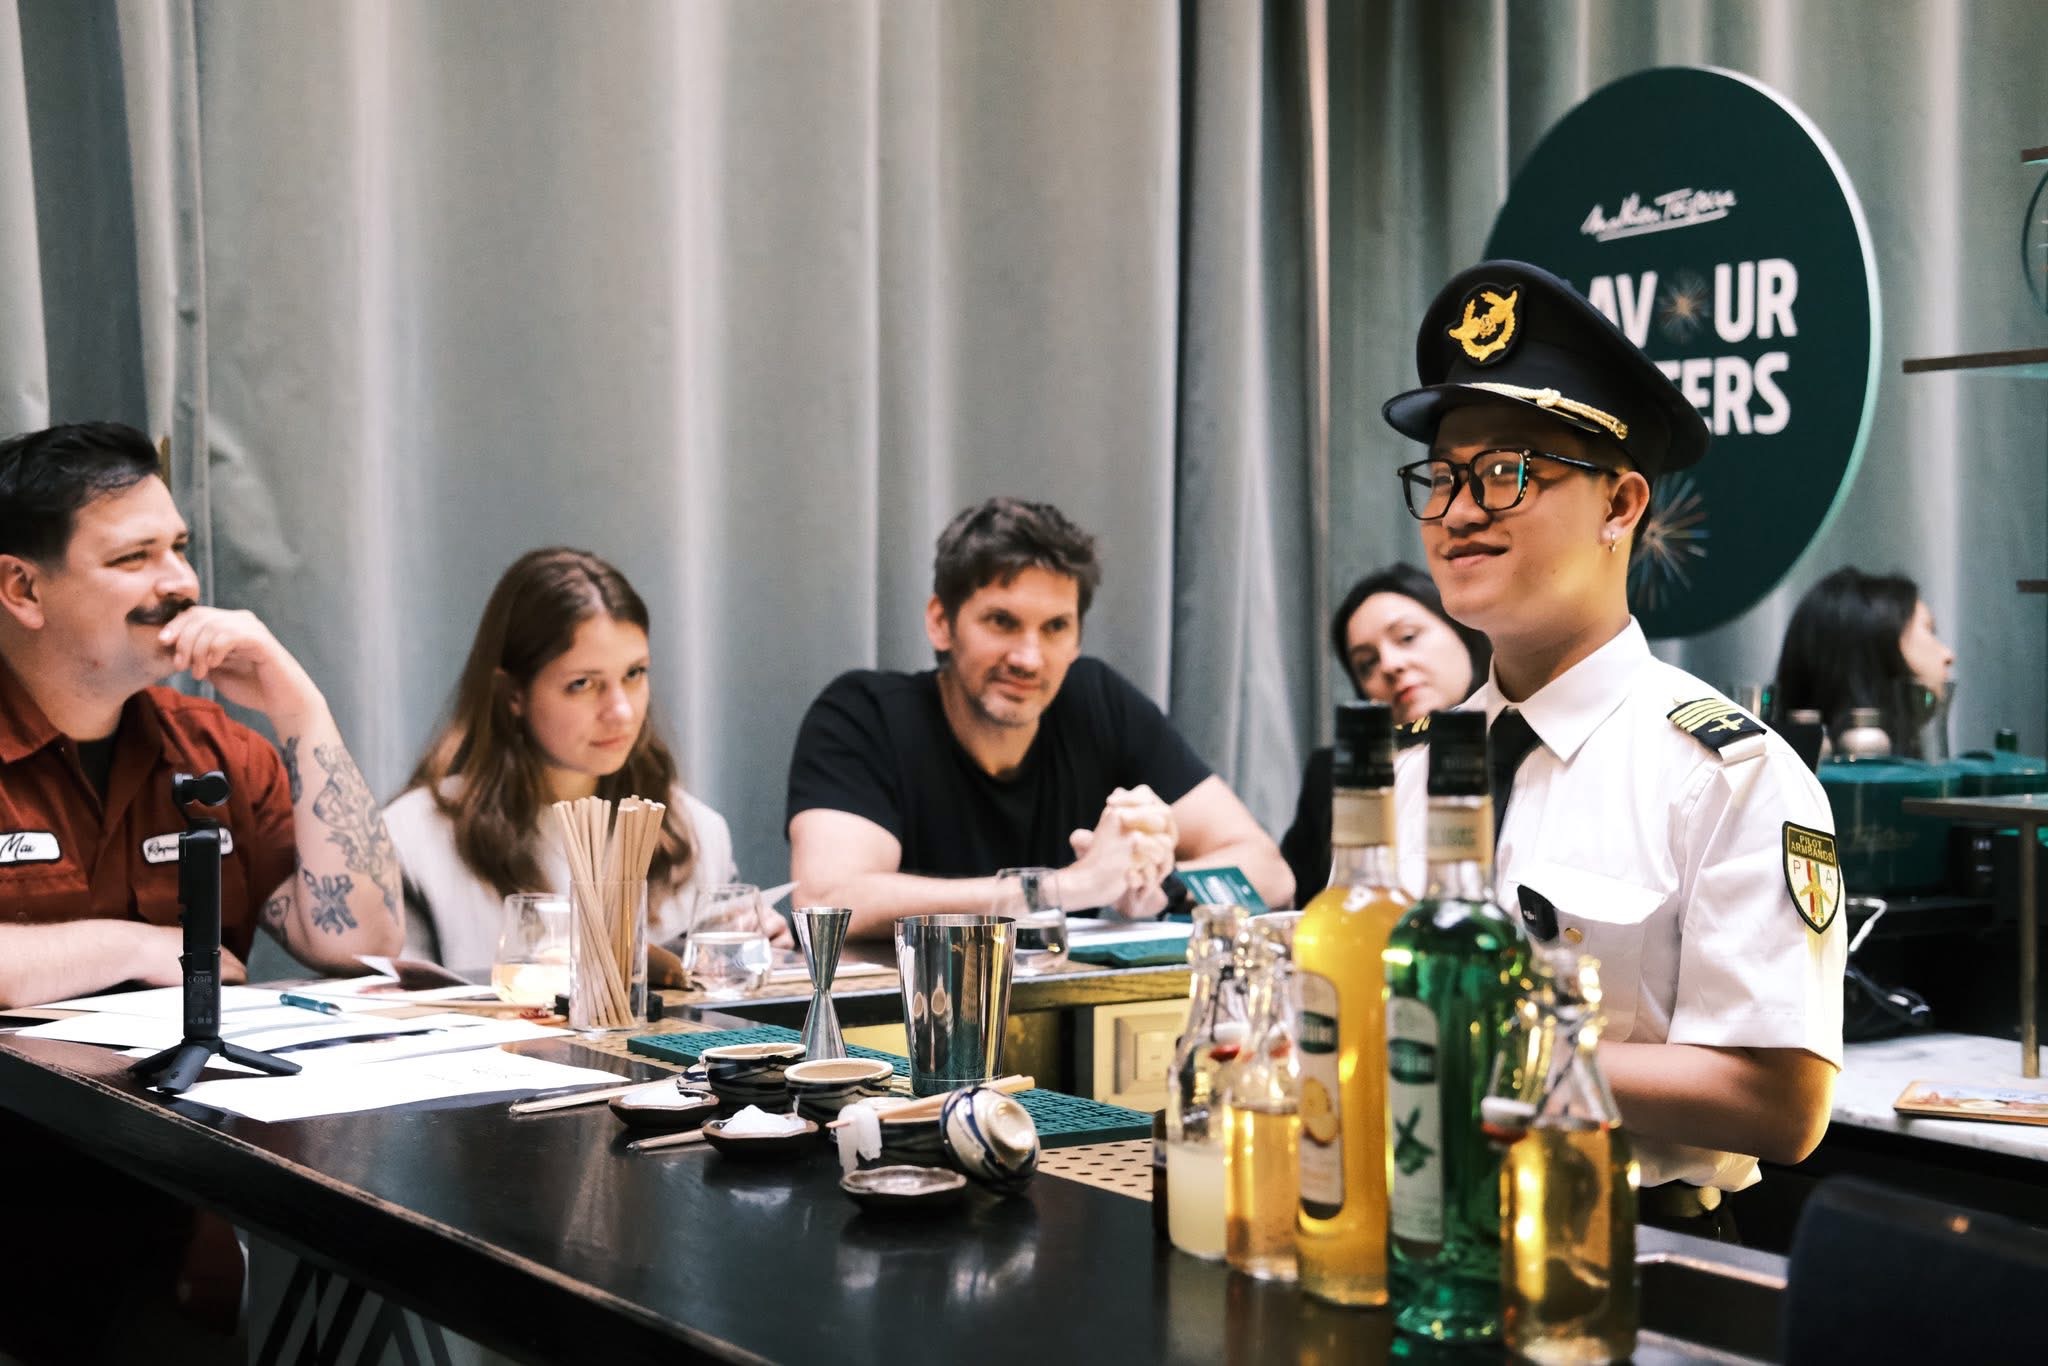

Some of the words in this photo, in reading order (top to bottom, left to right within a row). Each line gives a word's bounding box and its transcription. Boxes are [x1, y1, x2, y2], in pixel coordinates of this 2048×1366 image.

[1791, 841, 1834, 863] ARMBANDS
[1800, 834, 1822, 849] PILOT
[1793, 859, 1801, 875] P
[1826, 869, 1834, 885] A
